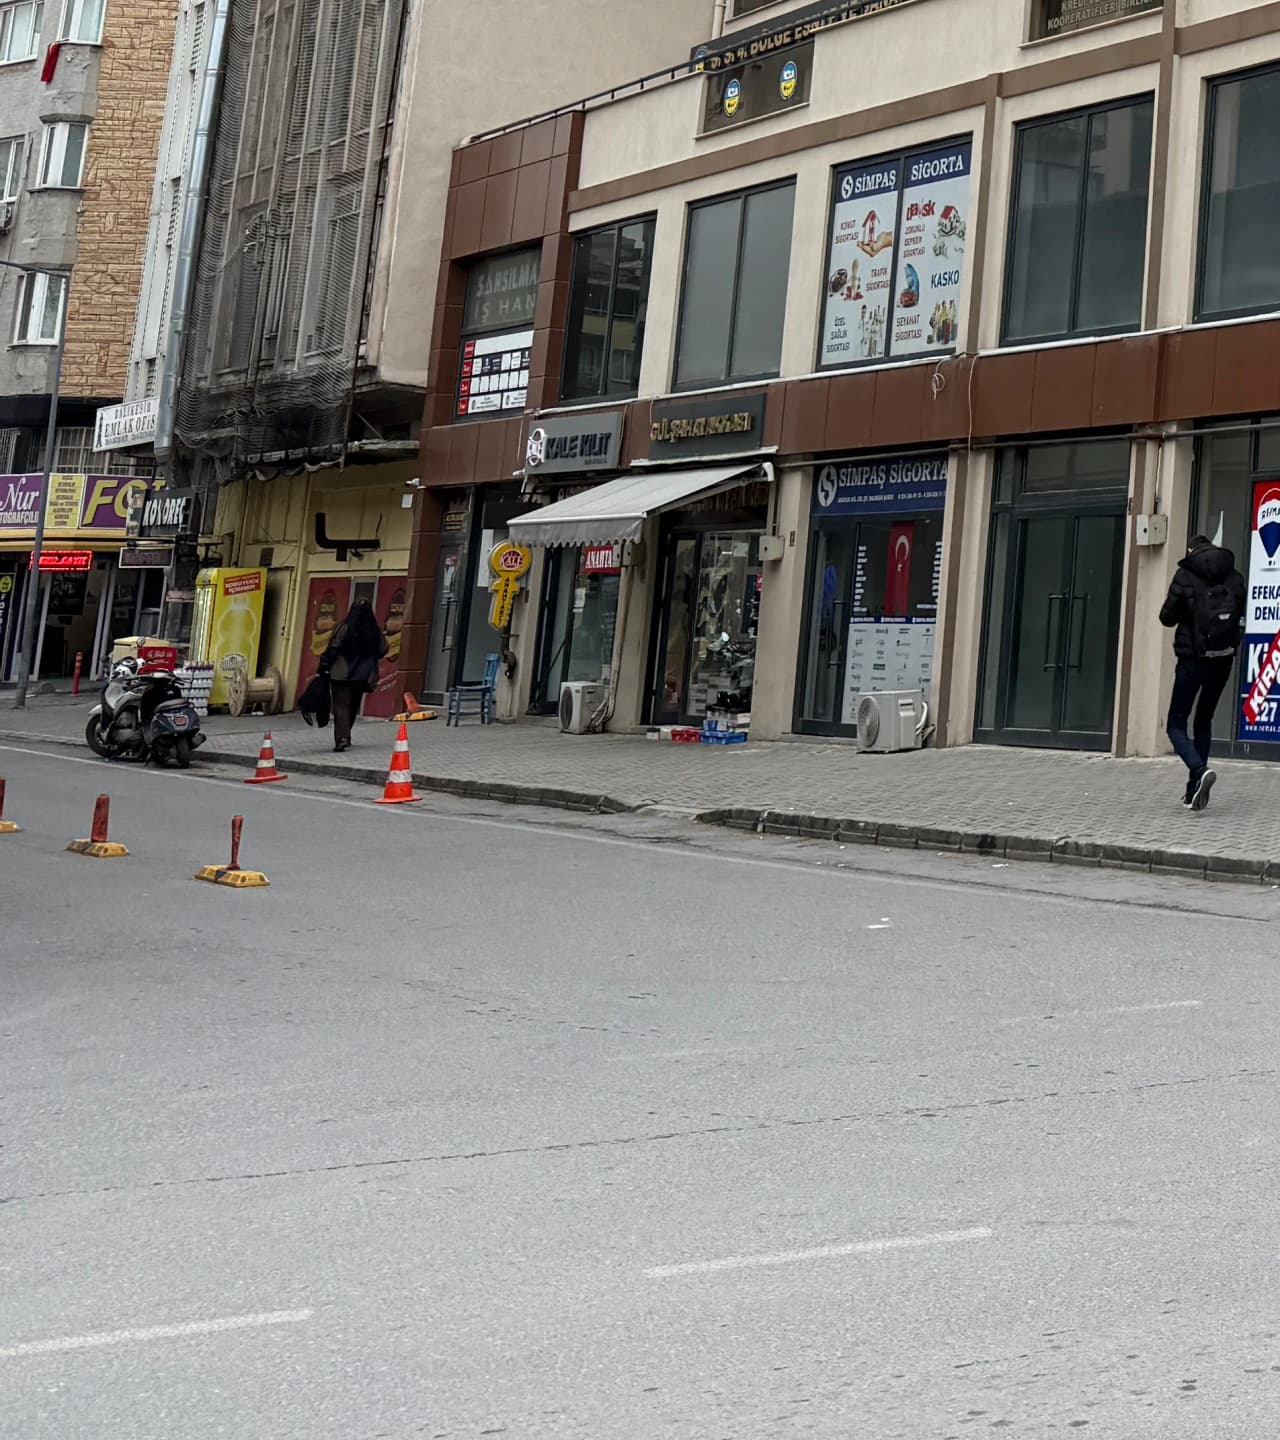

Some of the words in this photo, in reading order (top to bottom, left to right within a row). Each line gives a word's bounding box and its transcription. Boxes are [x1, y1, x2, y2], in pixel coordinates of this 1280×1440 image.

[910, 154, 964, 182] SİGORTA
[854, 169, 897, 194] SİMPAŞ
[476, 262, 538, 297] SARSILMA
[930, 269, 960, 289] KASKO
[104, 417, 135, 439] EMLAK
[838, 463, 887, 490] SİMPAŞ
[889, 459, 949, 484] SİGORTA
[0, 476, 40, 517] Nur
[584, 549, 614, 569] ANAHTA
